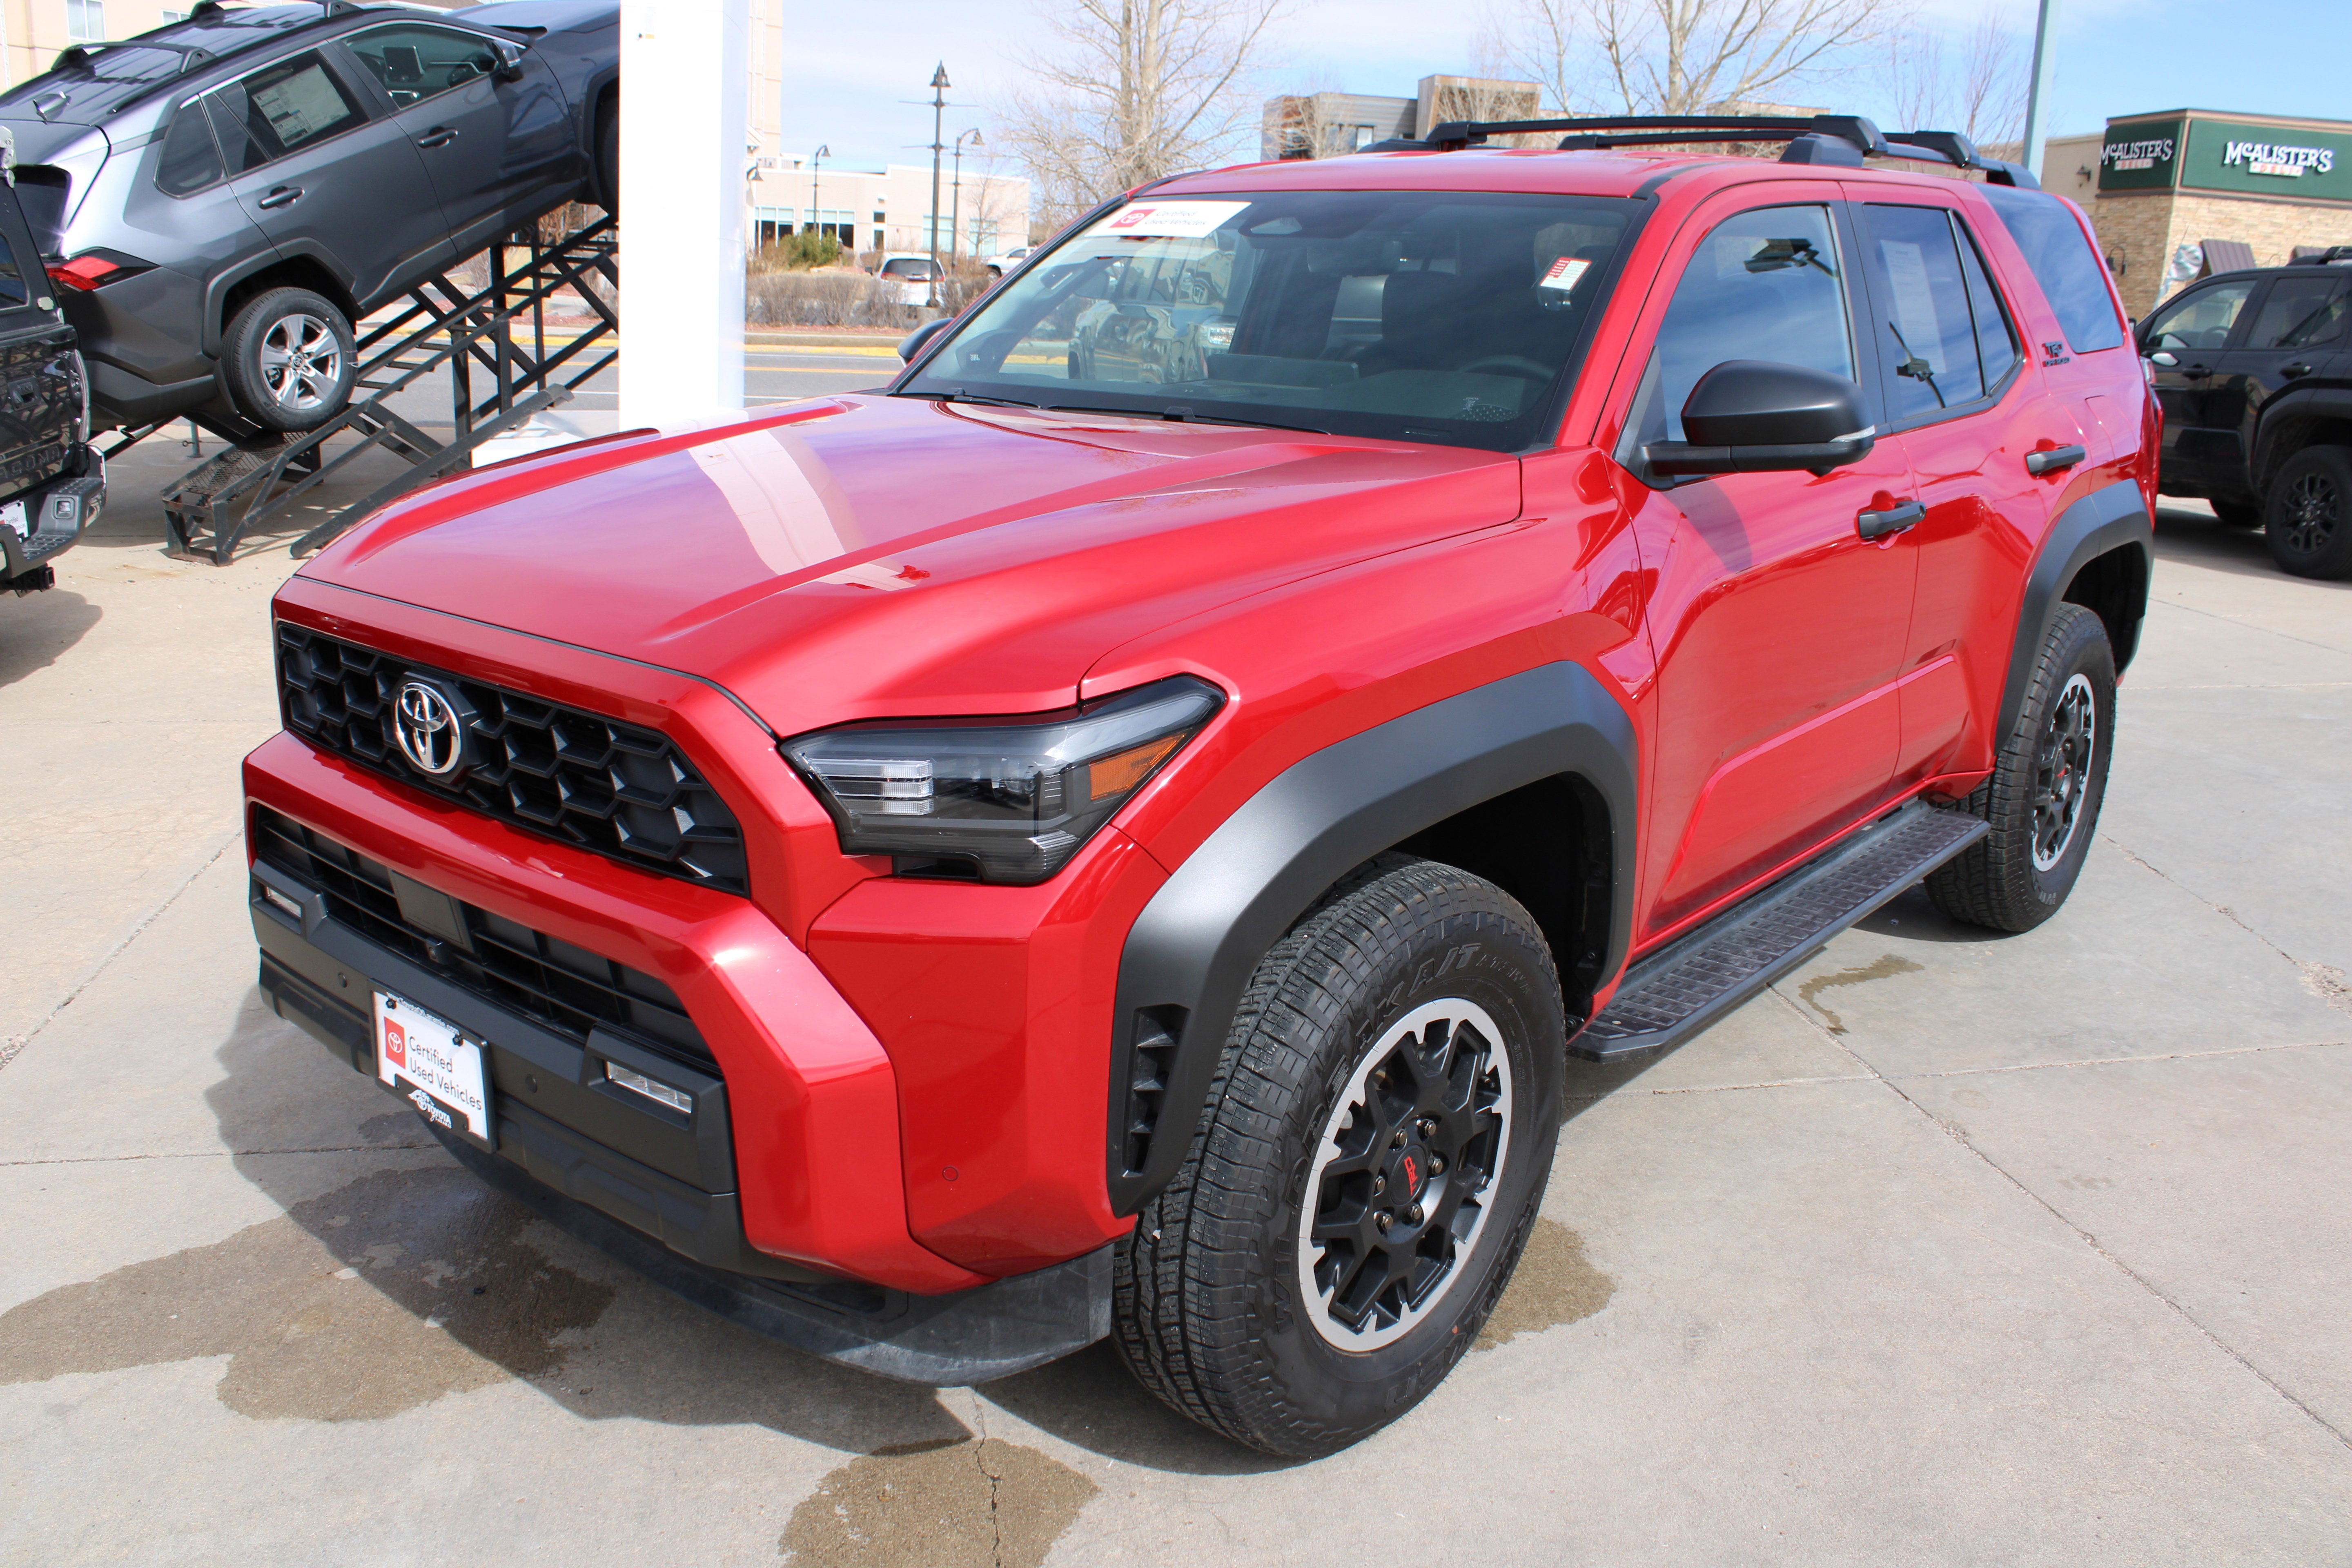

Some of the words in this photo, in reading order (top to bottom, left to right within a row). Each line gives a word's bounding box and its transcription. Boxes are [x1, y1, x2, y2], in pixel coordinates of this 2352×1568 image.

[410, 1036, 453, 1074] Certified
[410, 1057, 433, 1085] Used
[437, 1073, 482, 1111] Vehicles
[427, 1103, 452, 1125] TOYOTA
[1404, 1156, 1419, 1196] TRD
